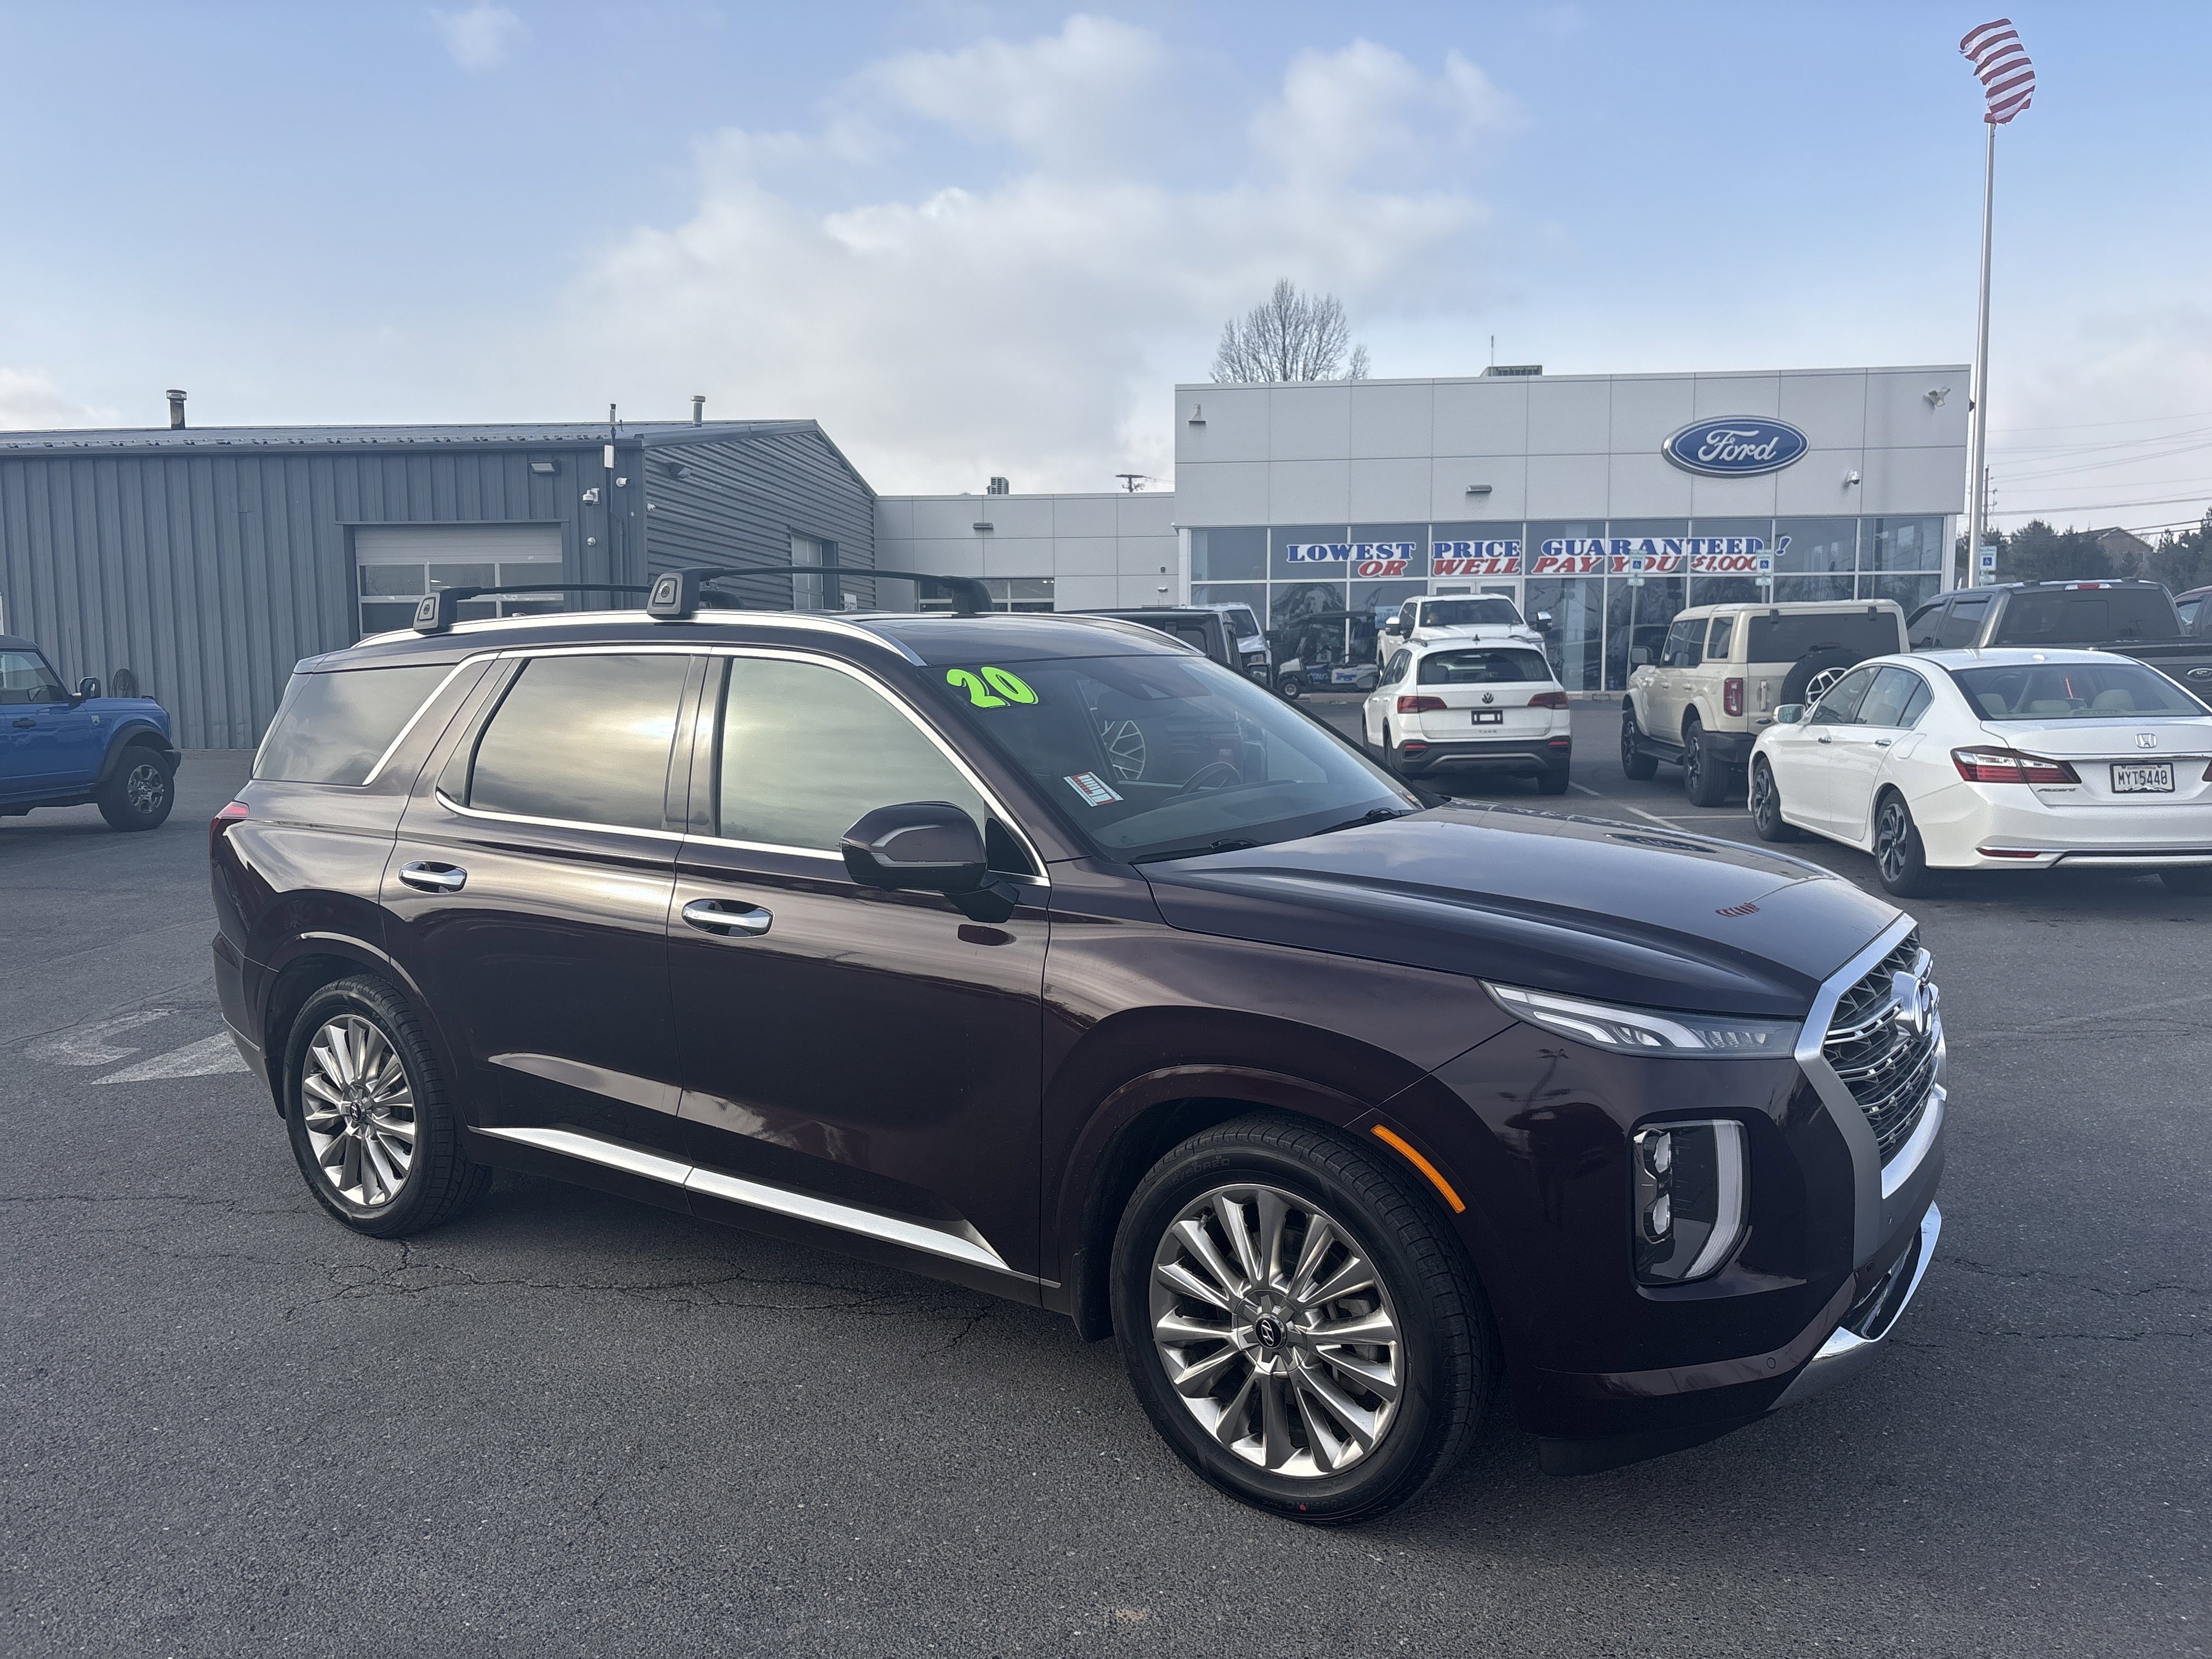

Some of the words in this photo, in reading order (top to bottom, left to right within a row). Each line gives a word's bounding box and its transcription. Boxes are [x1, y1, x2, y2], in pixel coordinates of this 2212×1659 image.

[1698, 429, 1780, 461] Ford
[1286, 543, 1415, 562] LOWEST
[1432, 540, 1521, 559] PRICE
[1542, 538, 1763, 556] GUARANTEED
[1358, 560, 1408, 577] OR
[1432, 558, 1520, 575] WE'LL
[1531, 556, 1602, 573] PAY
[946, 667, 1039, 709] 20
